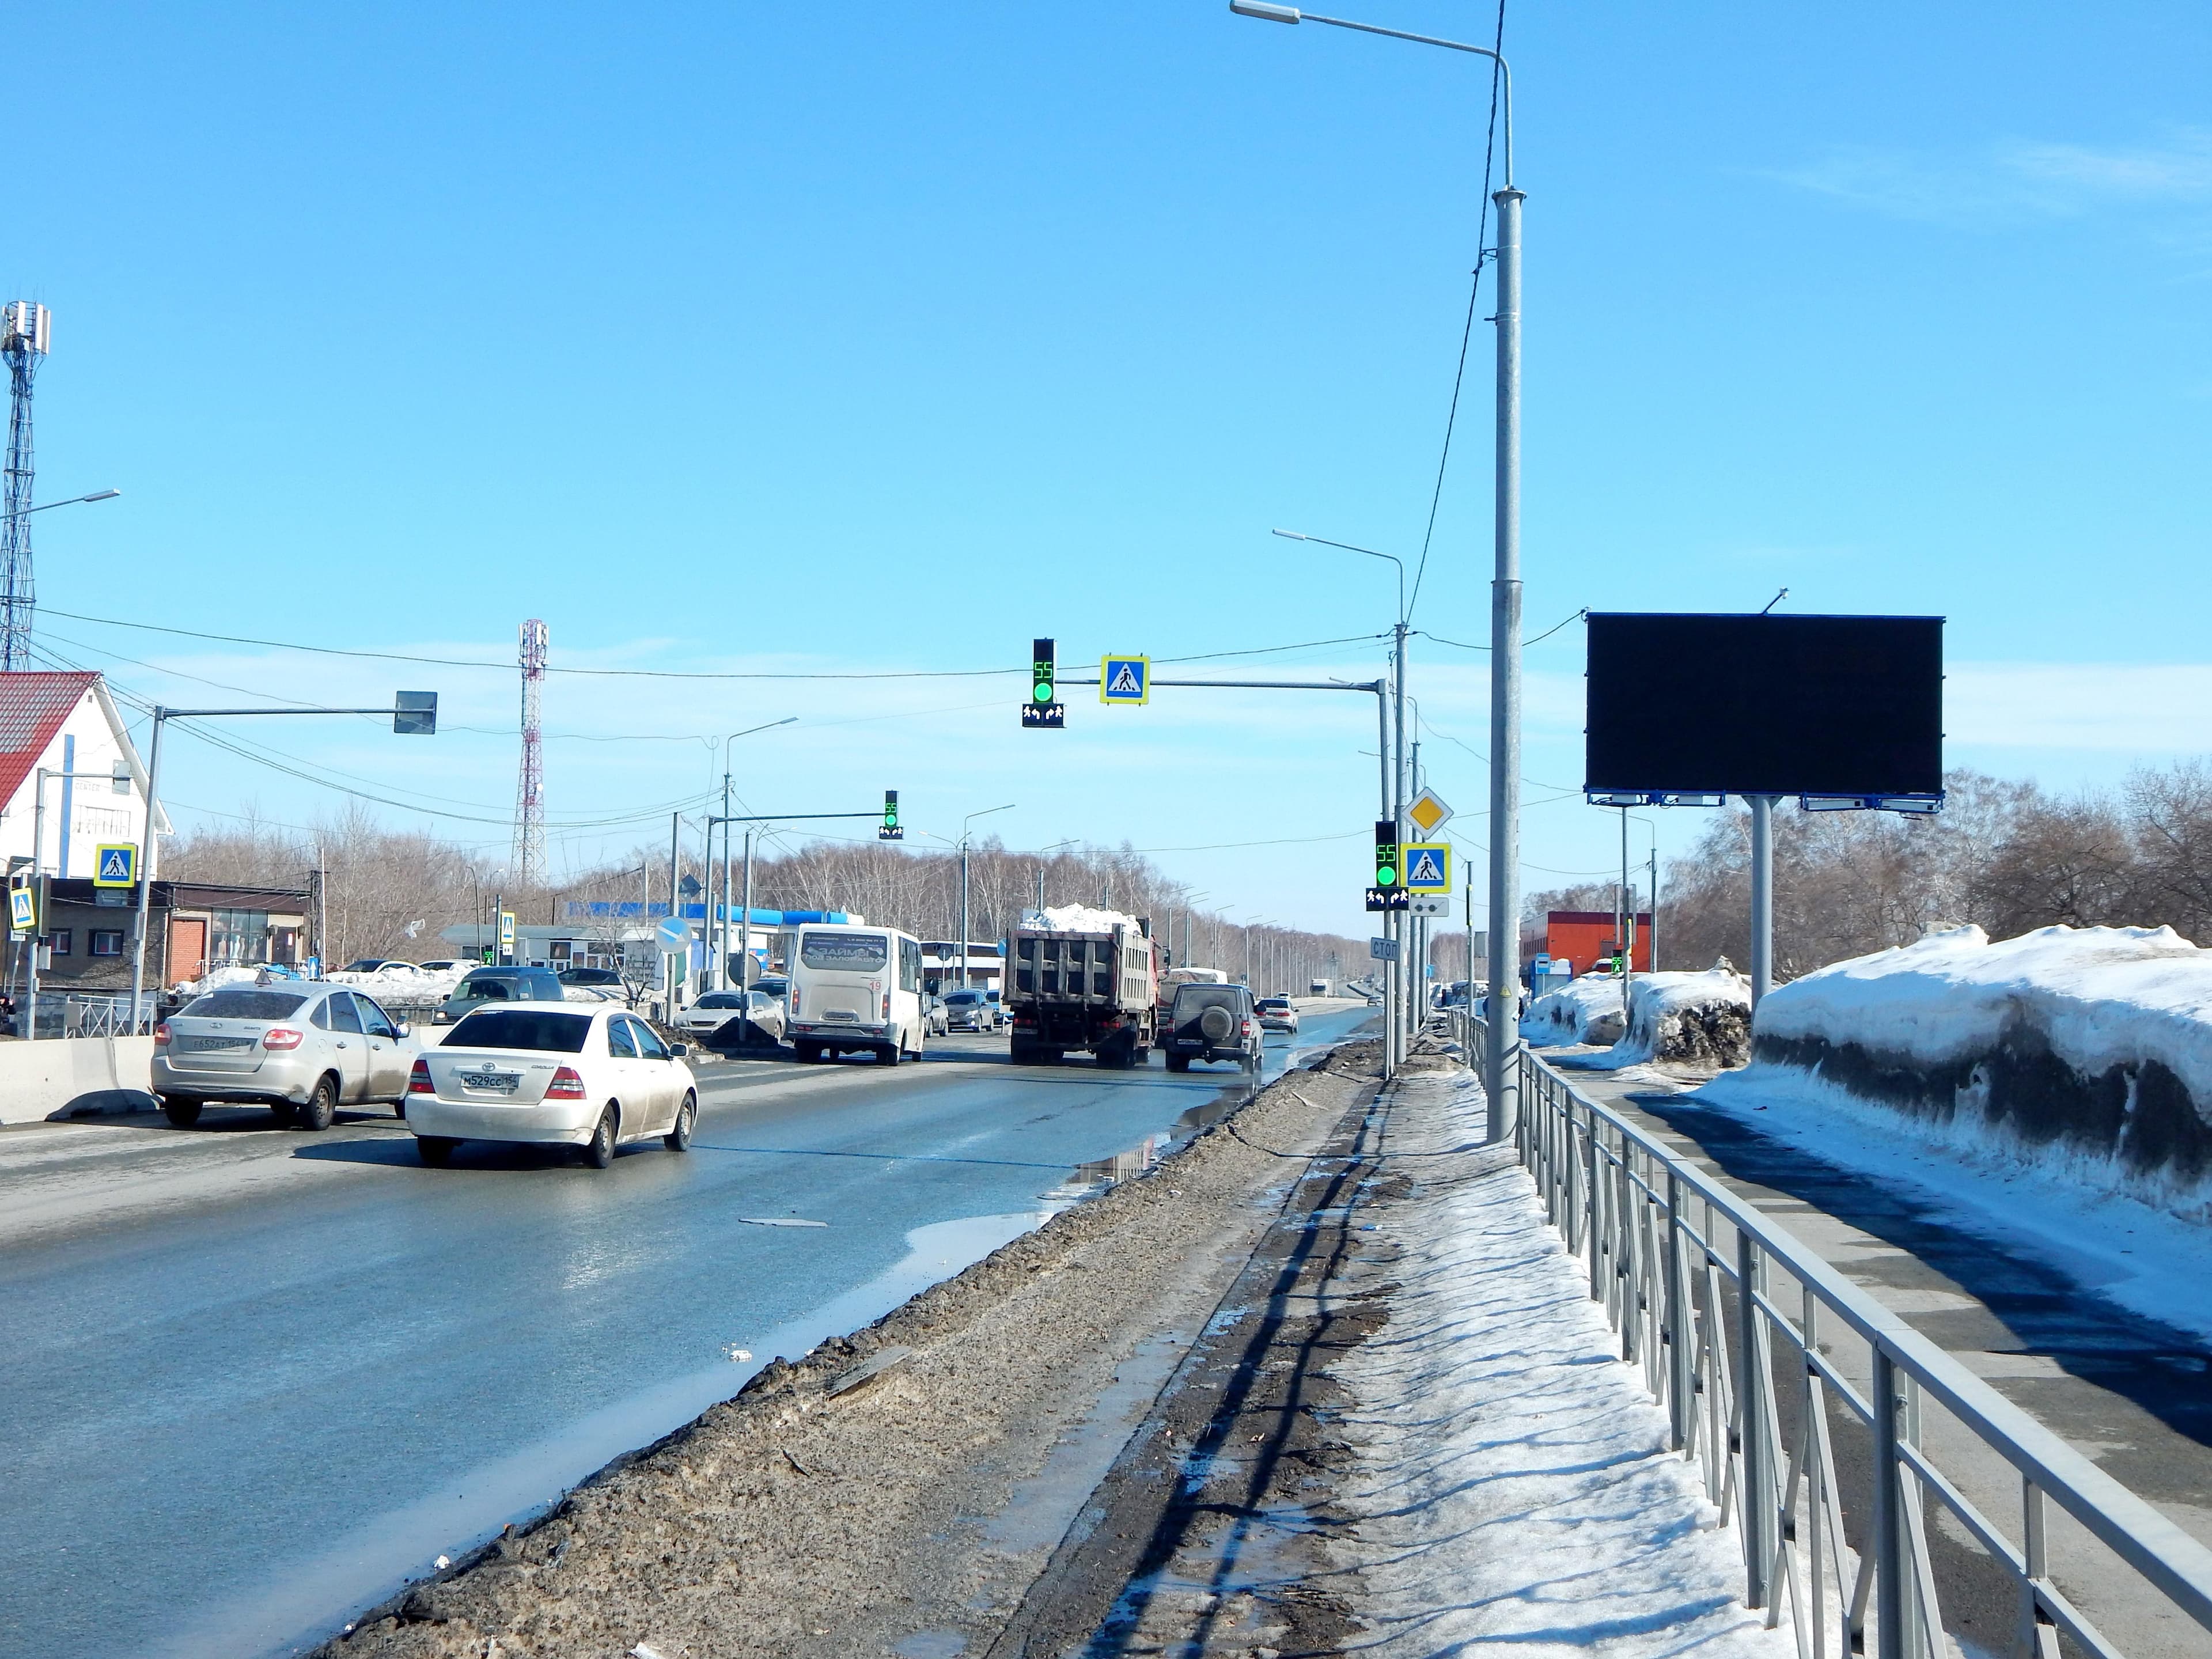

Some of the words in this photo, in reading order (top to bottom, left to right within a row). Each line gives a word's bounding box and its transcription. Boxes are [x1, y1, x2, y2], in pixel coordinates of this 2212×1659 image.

[1035, 662, 1052, 678] 55
[886, 802, 896, 813] 55
[1377, 844, 1396, 862] 55
[819, 947, 869, 957] ЗАЙМЫ
[1373, 941, 1397, 957] СТОП
[1612, 957, 1622, 965] 55
[869, 981, 881, 990] 19
[464, 1075, 502, 1086] М529СС
[505, 1077, 517, 1085] 154
